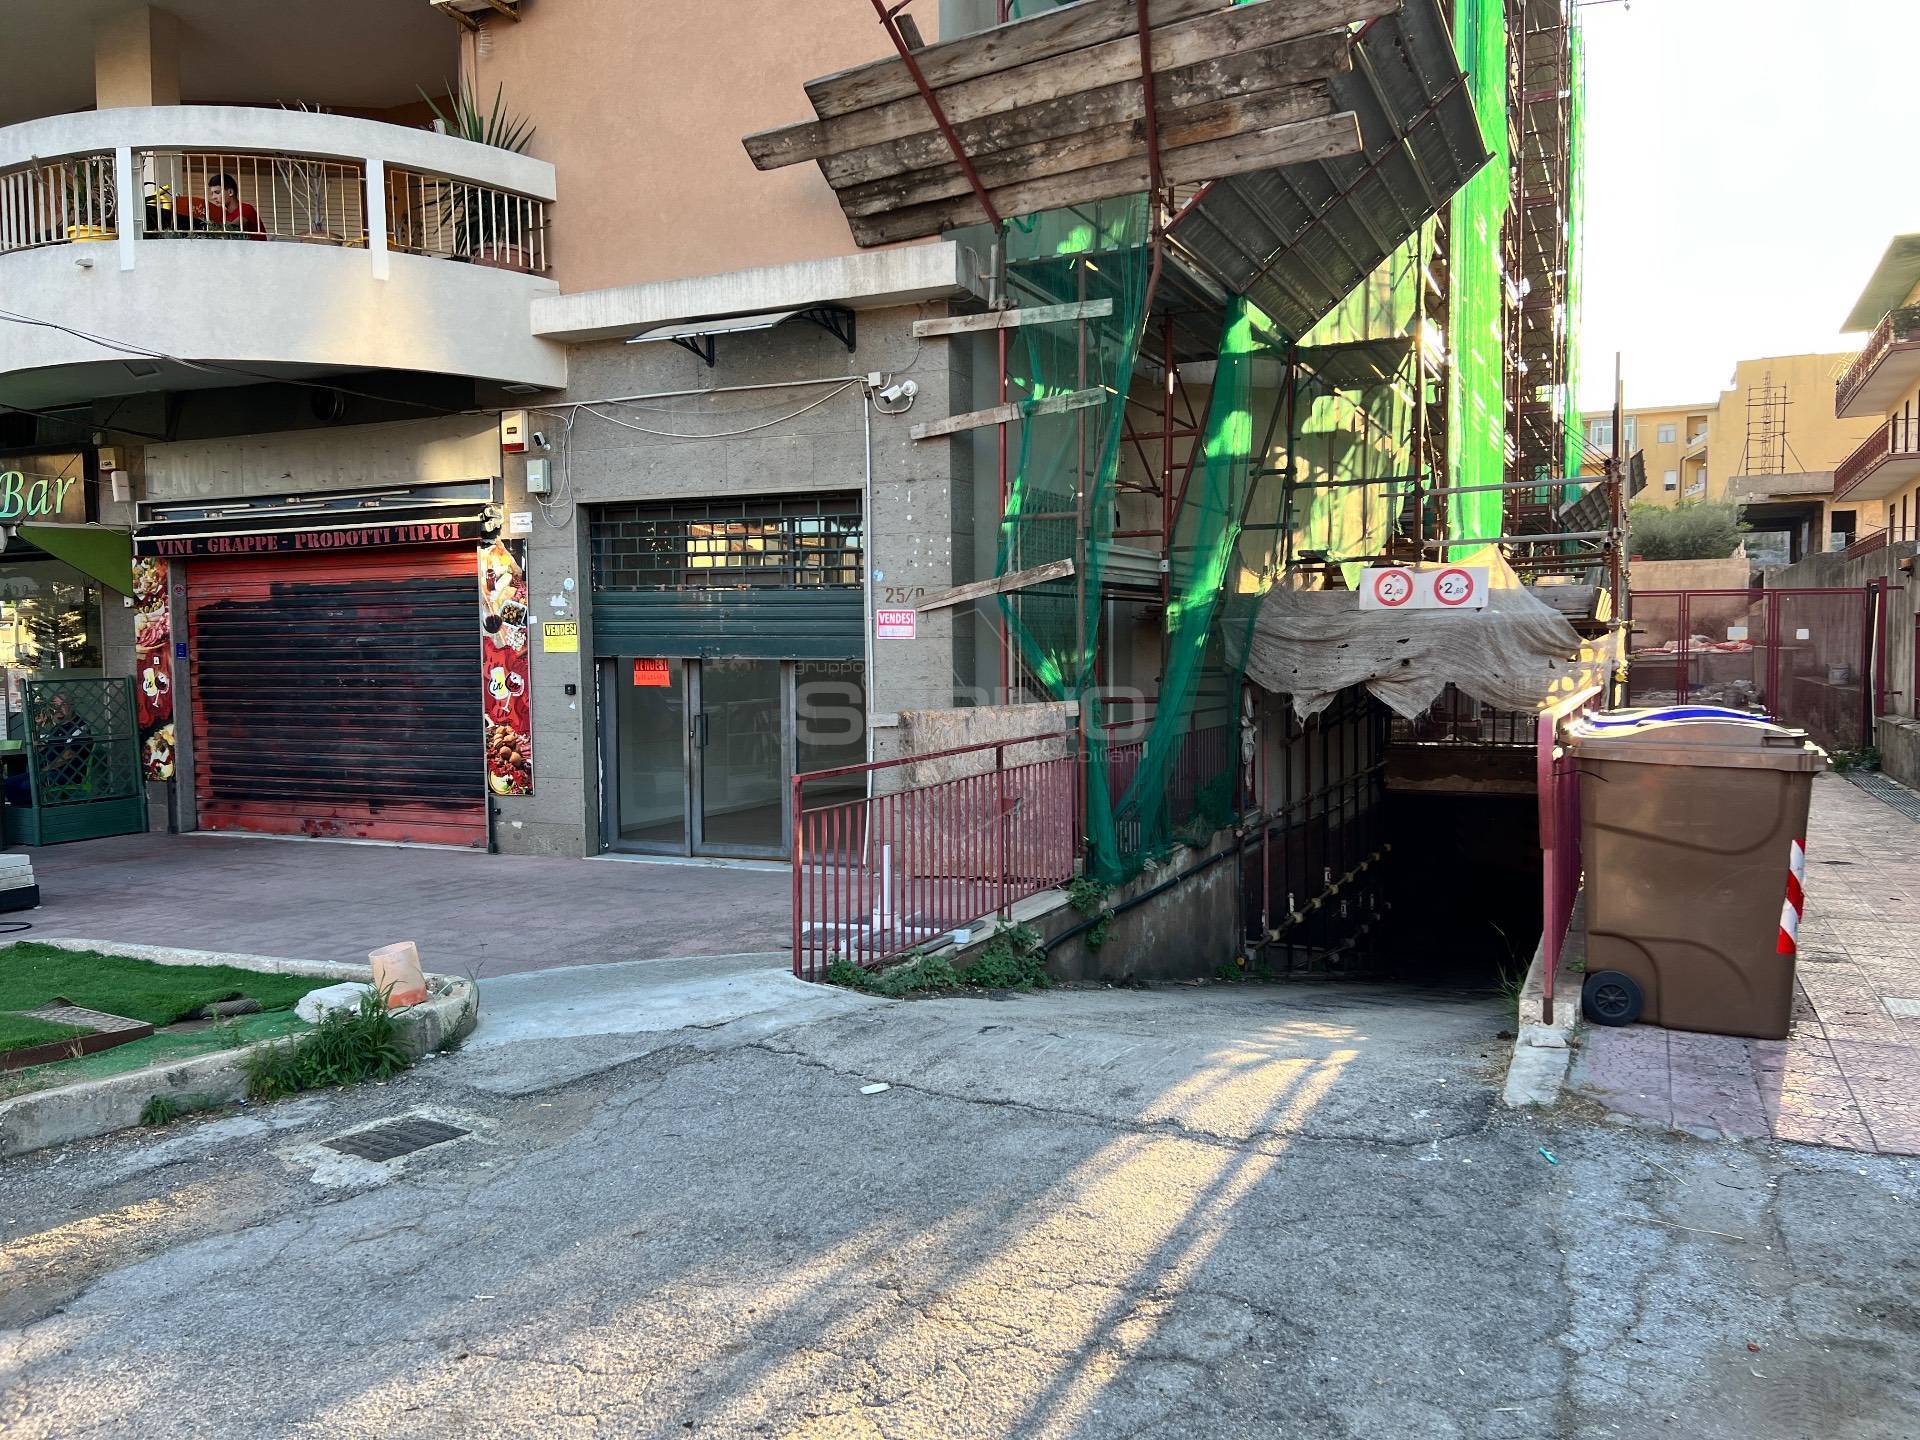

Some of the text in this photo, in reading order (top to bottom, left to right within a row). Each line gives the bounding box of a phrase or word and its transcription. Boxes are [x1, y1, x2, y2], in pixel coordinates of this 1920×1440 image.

[0, 470, 77, 518] Bar
[156, 539, 193, 555] VINI
[207, 535, 278, 553] GRAPPE
[294, 527, 391, 549] PRODOTTI
[394, 523, 460, 542] TIPICI
[545, 624, 577, 635] VENDESI
[879, 612, 914, 625] VENDESI
